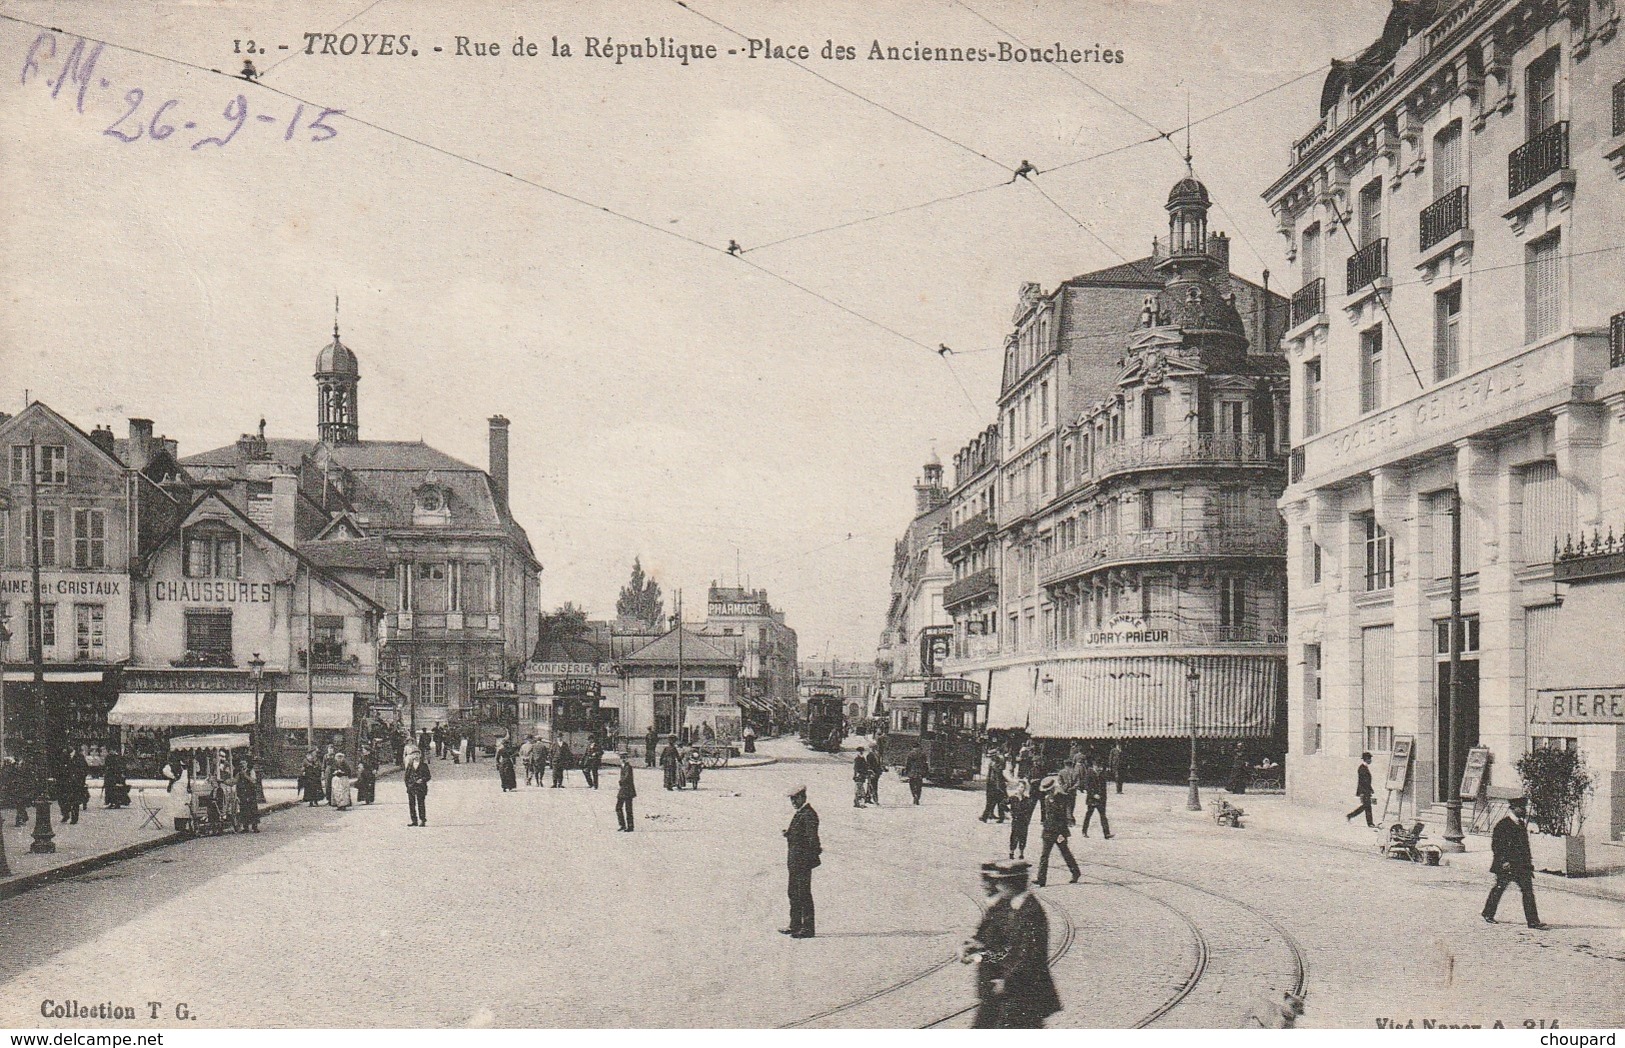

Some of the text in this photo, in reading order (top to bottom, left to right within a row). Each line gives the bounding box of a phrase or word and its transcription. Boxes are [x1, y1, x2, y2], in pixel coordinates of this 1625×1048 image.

[155, 581, 272, 602] CHAUSSURES
[708, 603, 761, 615] PHARMACIE
[1108, 614, 1143, 630] ANNEXE
[531, 663, 591, 674] CONFISERIE
